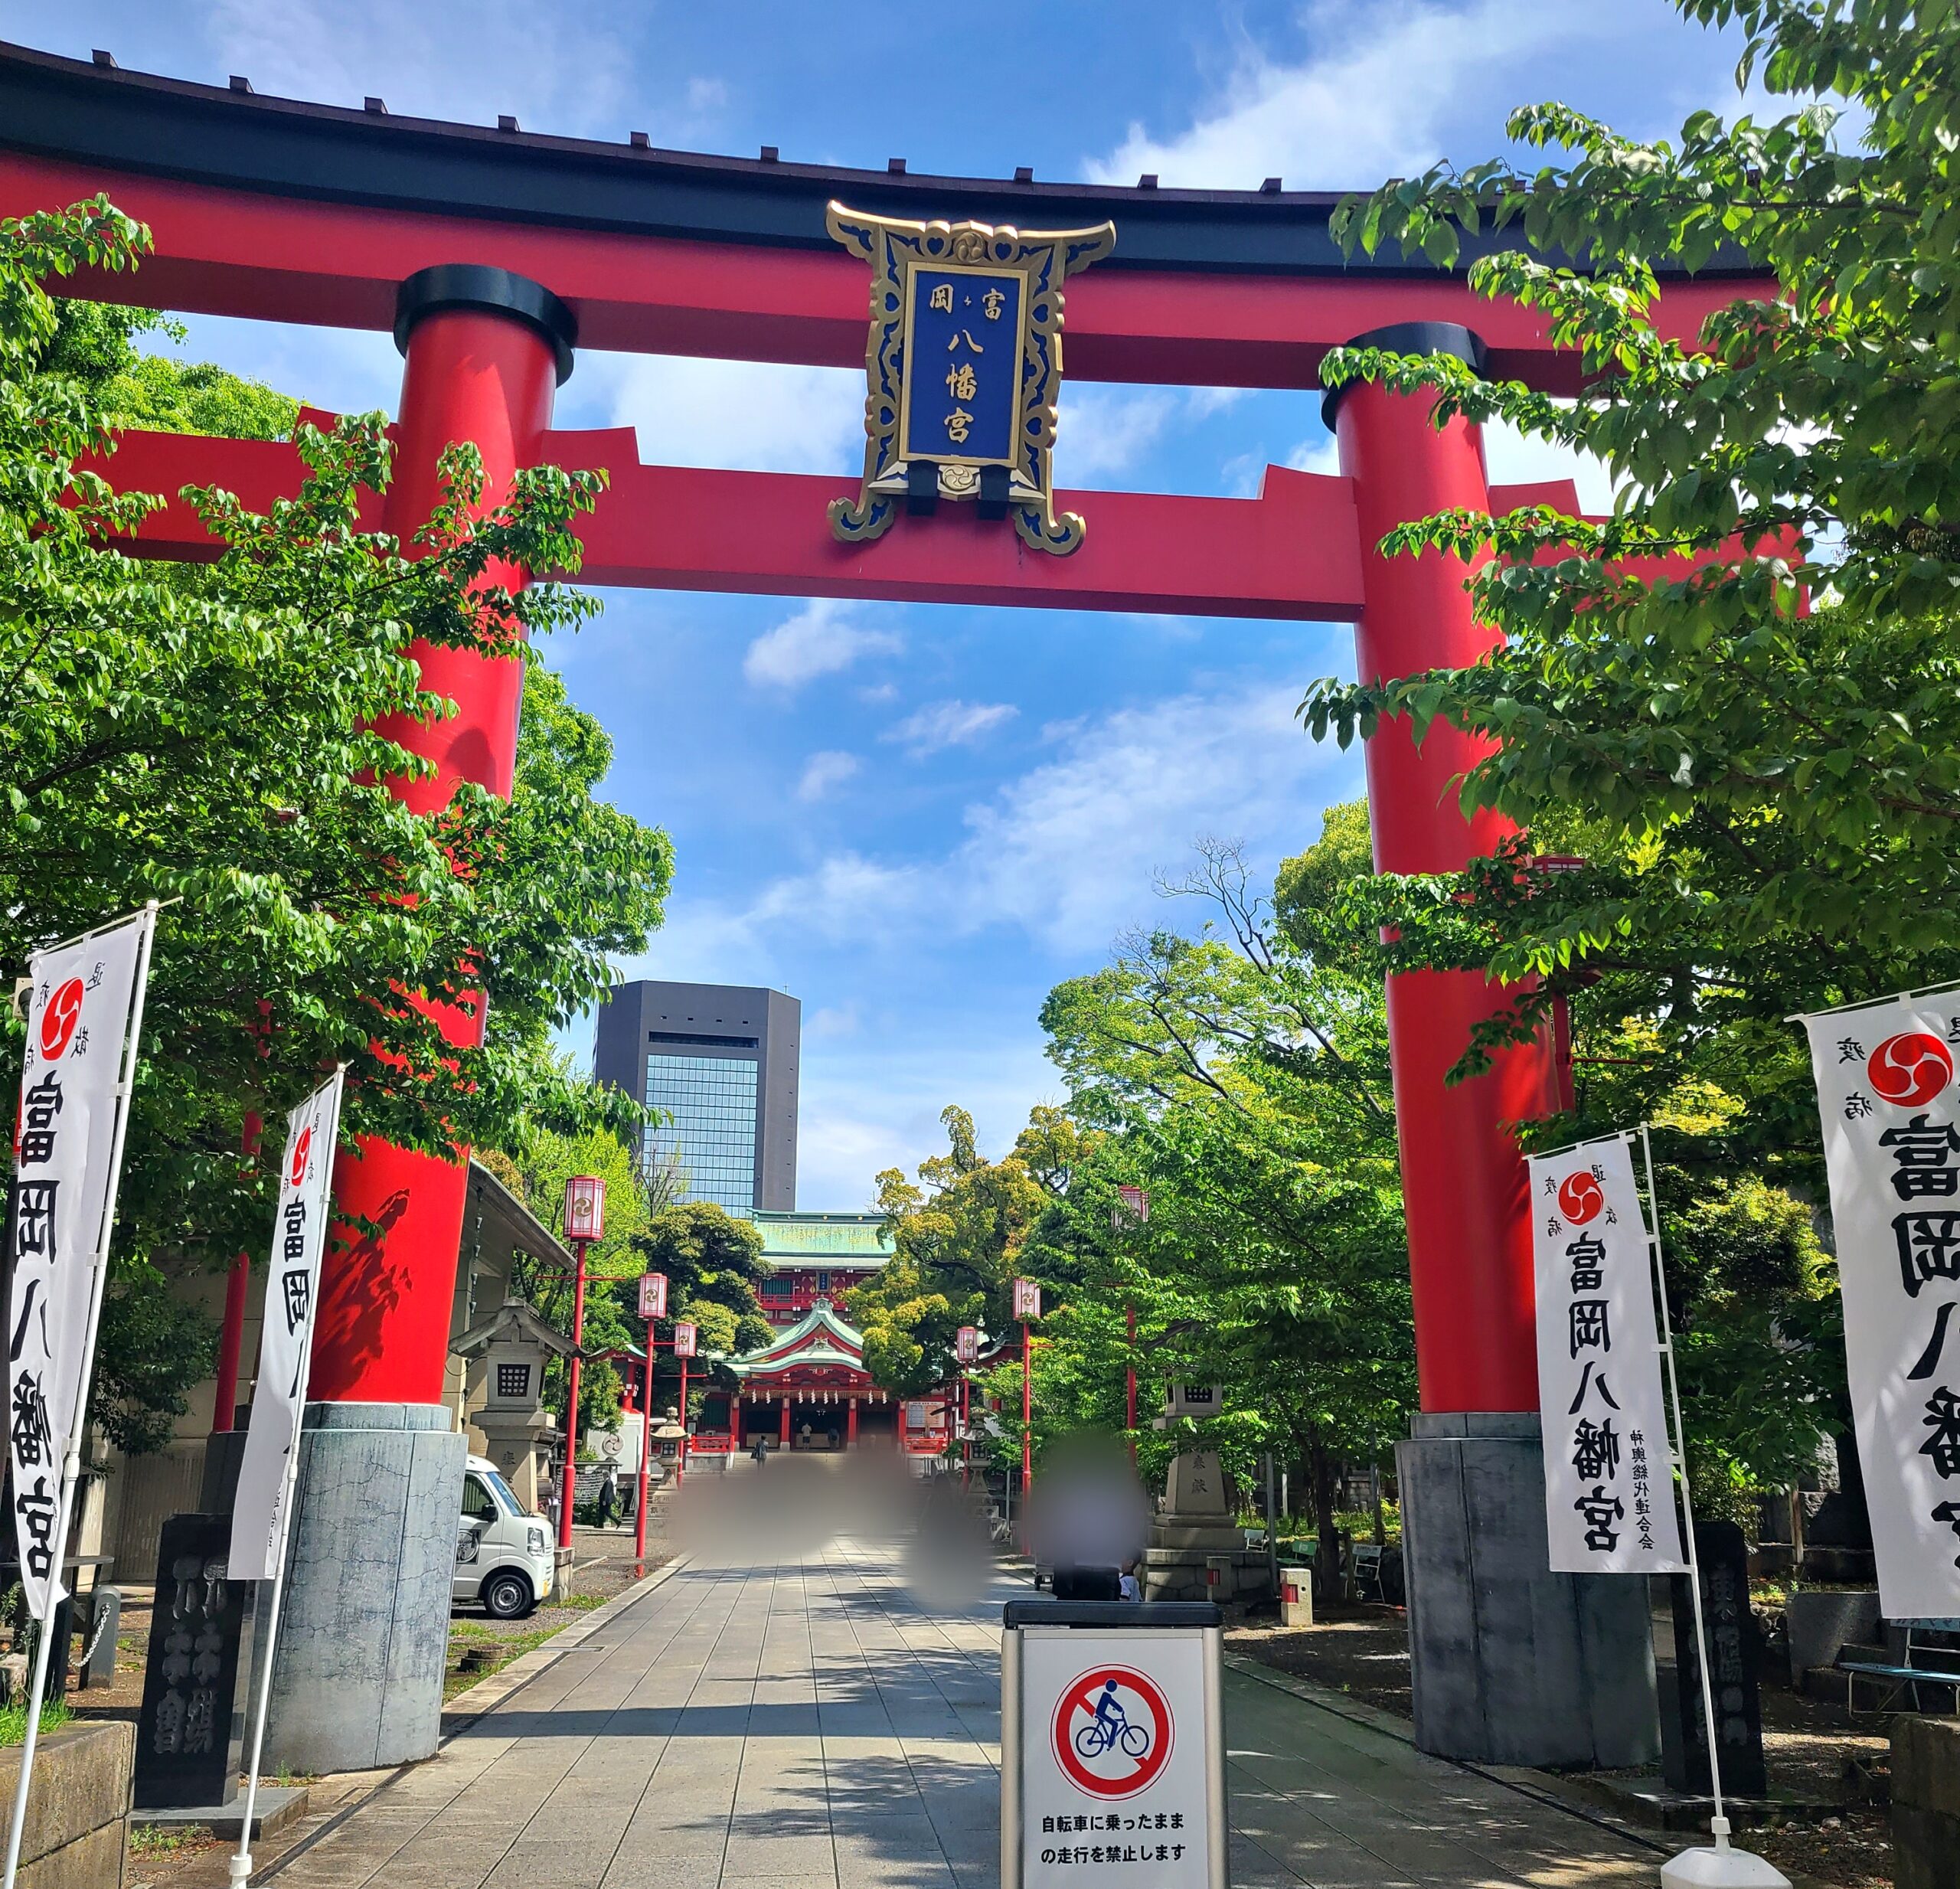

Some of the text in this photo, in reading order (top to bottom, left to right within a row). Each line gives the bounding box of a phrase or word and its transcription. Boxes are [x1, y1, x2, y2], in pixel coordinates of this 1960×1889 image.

[1042, 1812, 1184, 1833] 自転車に乗ったまま
[1040, 1844, 1186, 1864] の走行を禁止します
